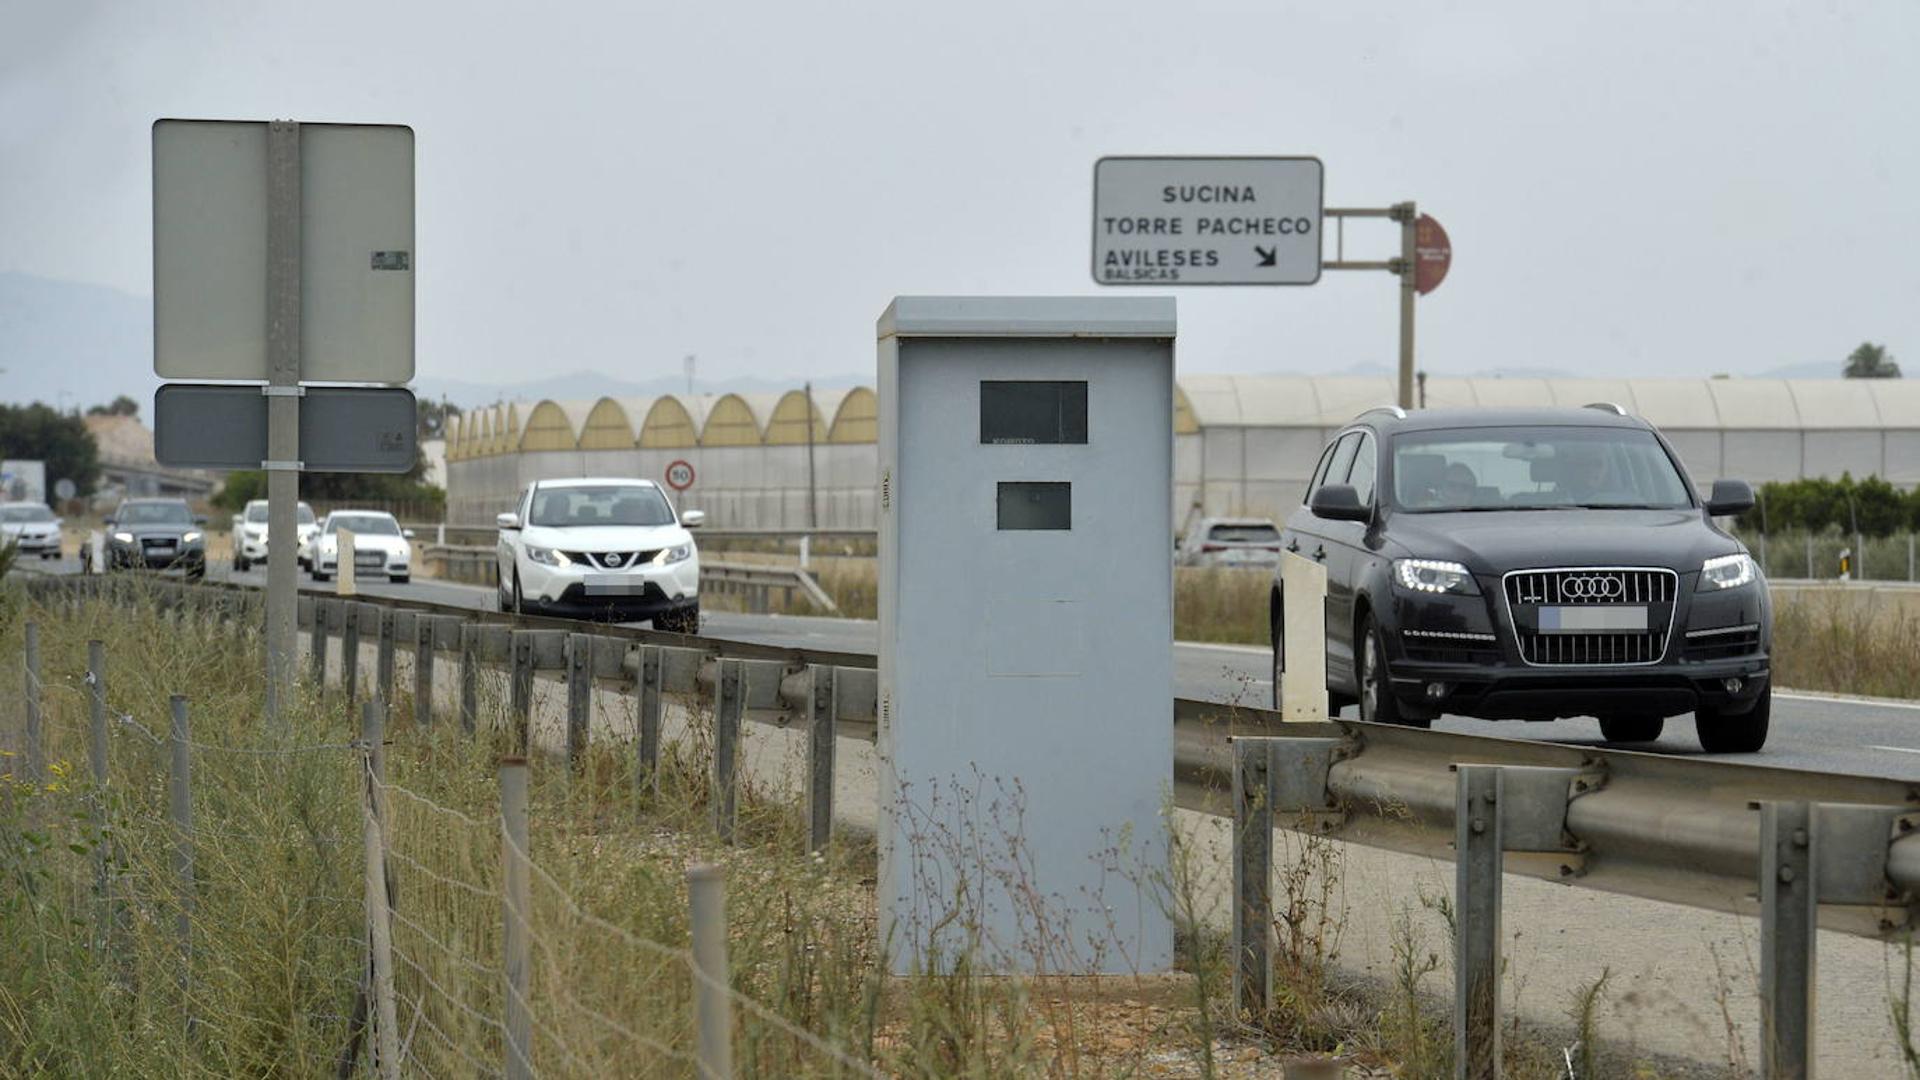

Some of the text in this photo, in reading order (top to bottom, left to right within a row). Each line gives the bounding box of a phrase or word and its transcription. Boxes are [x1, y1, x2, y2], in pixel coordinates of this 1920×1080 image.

[1163, 185, 1256, 203] SUCINA
[1104, 217, 1312, 235] TORRE PACHECO
[1104, 250, 1219, 267] AVILESES
